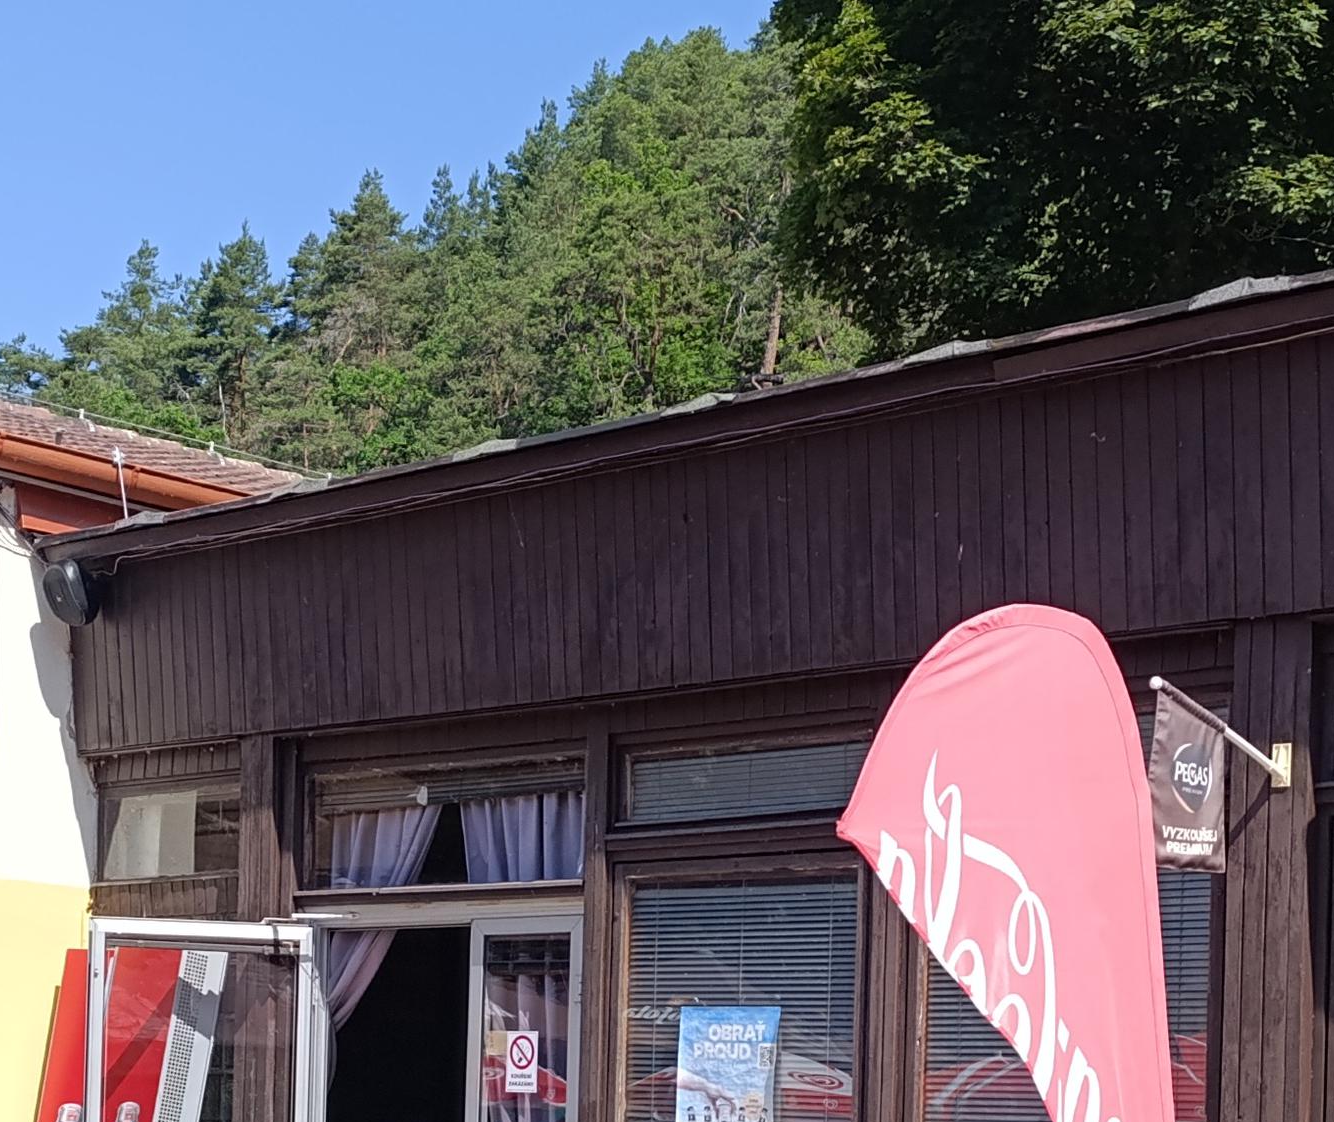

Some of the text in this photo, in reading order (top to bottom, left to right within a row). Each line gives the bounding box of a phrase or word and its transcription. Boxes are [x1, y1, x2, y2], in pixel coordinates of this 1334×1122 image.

[1174, 761, 1208, 786] PEGAS
[1161, 825, 1218, 842] VYZKOUŠEJ
[1166, 840, 1214, 856] PREMIUM
[709, 1020, 766, 1042] OBRAŤ
[693, 1043, 751, 1061] PROUD
